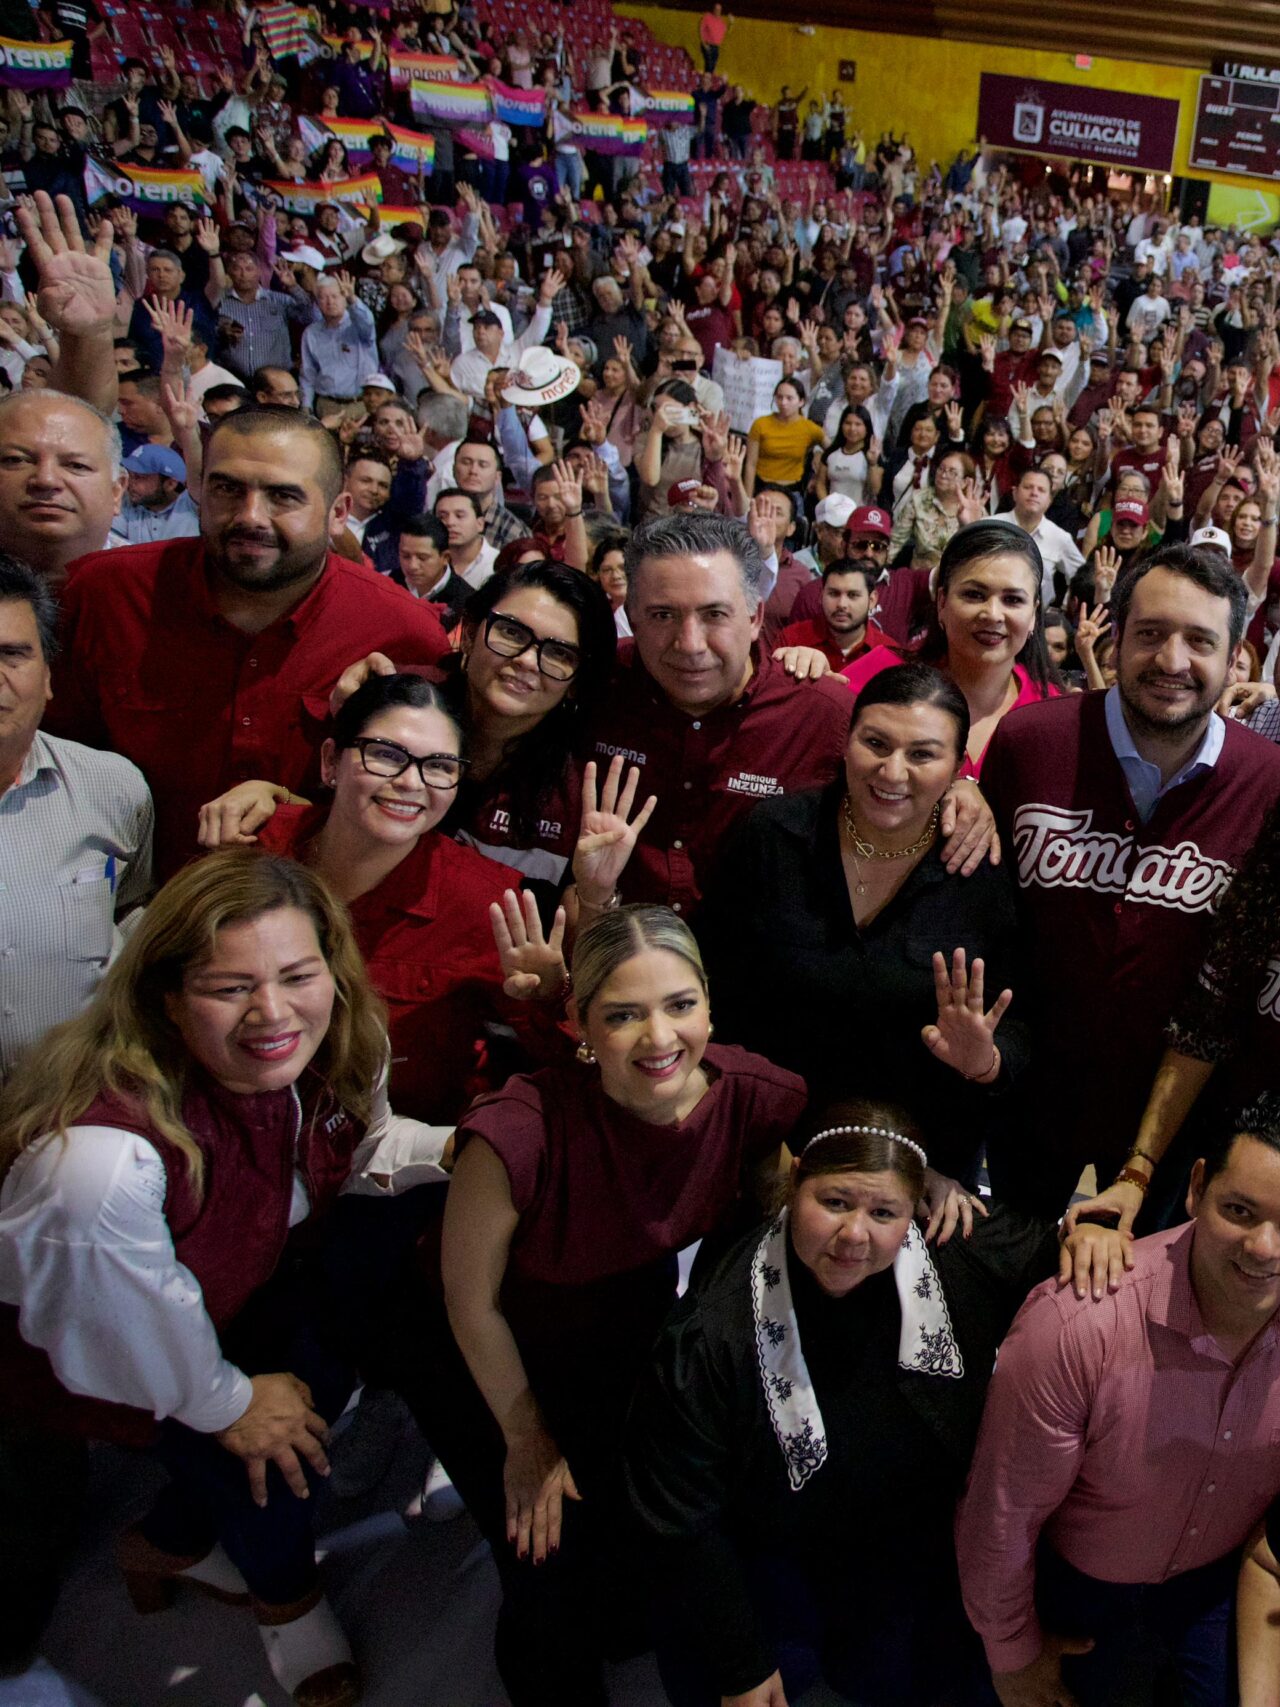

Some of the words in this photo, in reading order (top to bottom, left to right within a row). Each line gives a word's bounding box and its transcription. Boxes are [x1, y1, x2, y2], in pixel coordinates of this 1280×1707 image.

[1051, 108, 1126, 128] AYUNTAMIENTO
[1127, 120, 1141, 129] DE
[595, 741, 647, 765] morena
[728, 777, 784, 796] INZUNZA
[739, 772, 777, 785] ENRIQUE
[1012, 802, 1237, 915] Tomater
